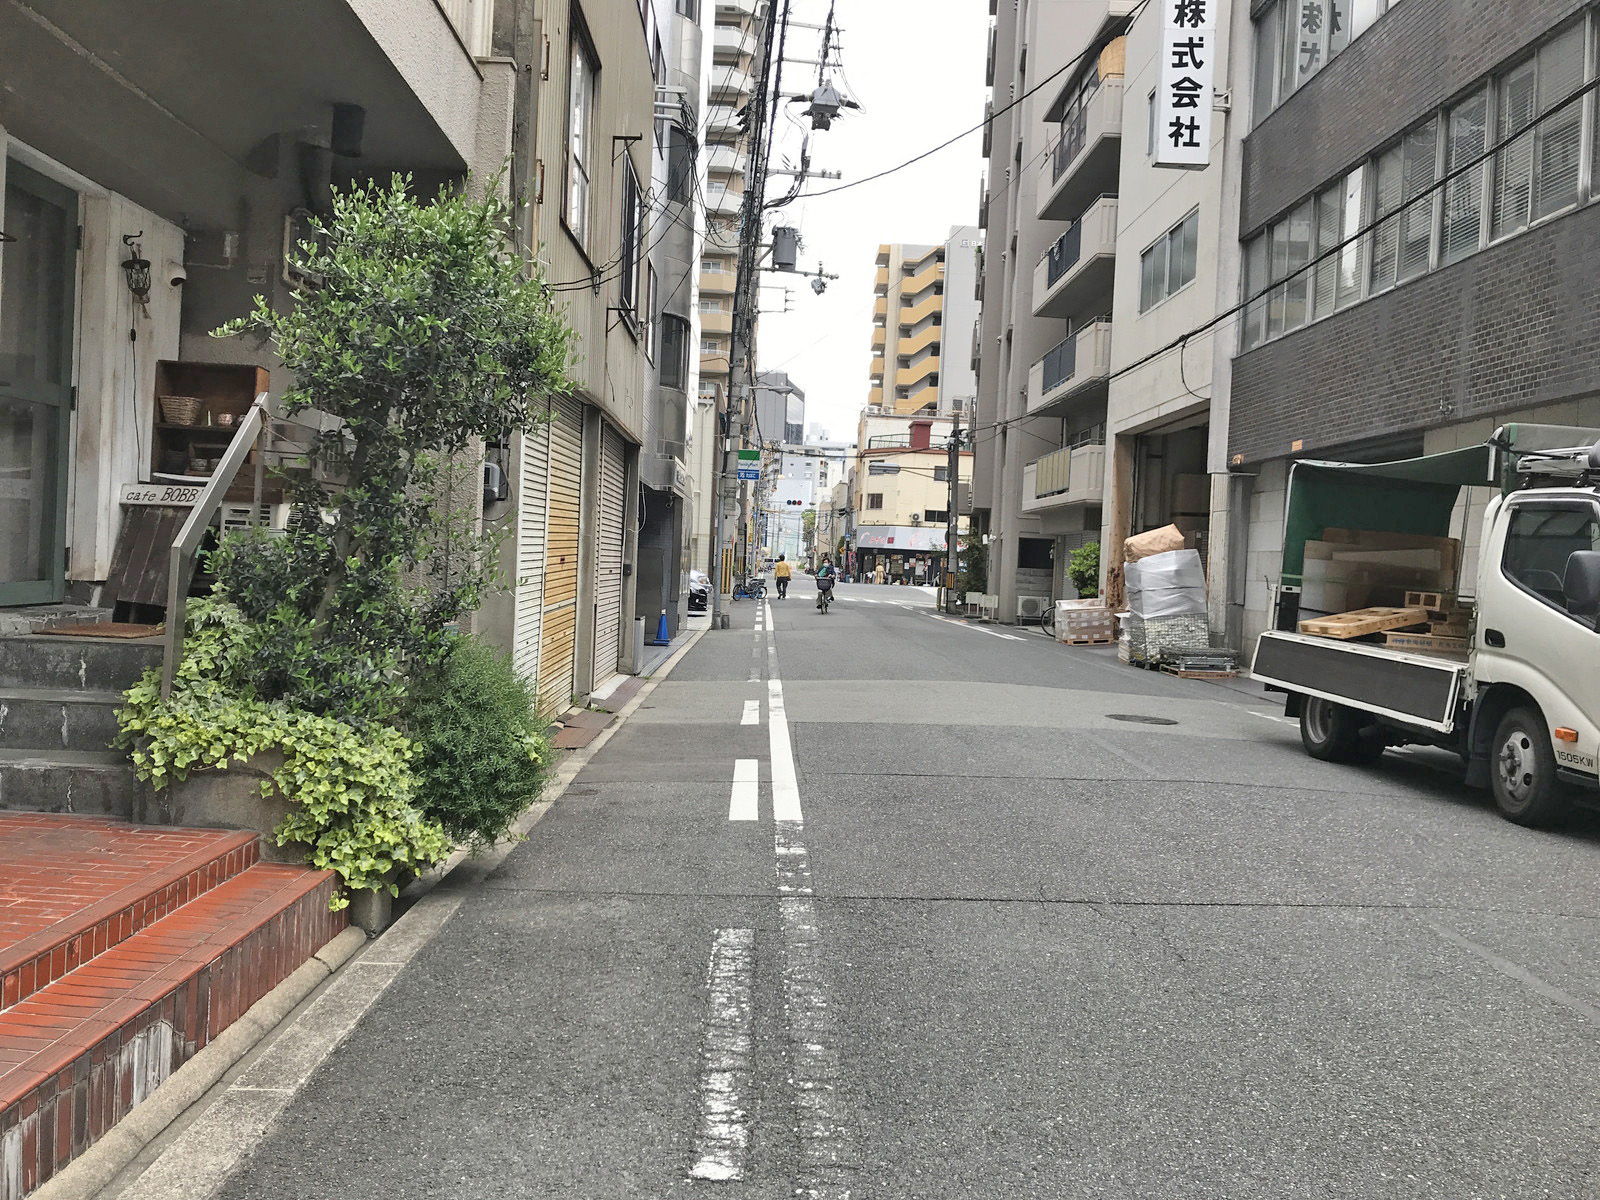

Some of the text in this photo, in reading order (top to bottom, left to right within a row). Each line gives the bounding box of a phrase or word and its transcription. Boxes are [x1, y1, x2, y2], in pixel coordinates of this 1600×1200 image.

[1168, 0, 1206, 148] 株式会社
[125, 490, 157, 502] cafe
